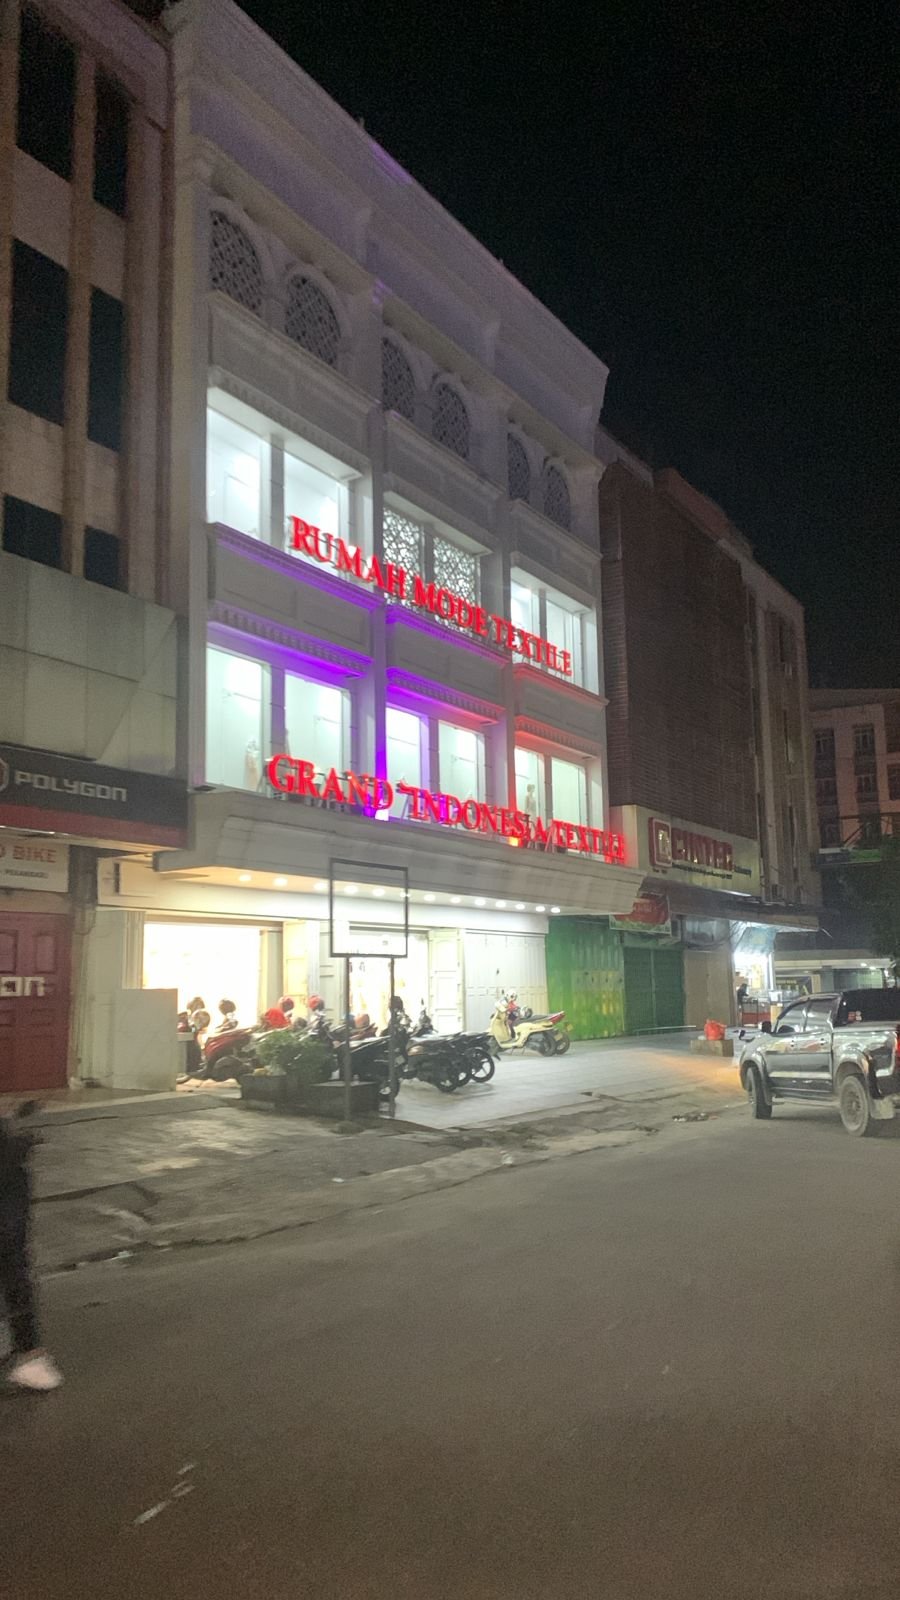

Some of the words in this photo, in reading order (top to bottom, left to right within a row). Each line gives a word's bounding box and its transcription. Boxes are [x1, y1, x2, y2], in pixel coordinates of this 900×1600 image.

[291, 515, 406, 600] RUMAH
[411, 574, 488, 637] MODE
[490, 615, 573, 677] TEXTILE
[15, 770, 127, 802] POLYGON
[267, 753, 394, 811] GRAND
[12, 845, 57, 863] BIKE
